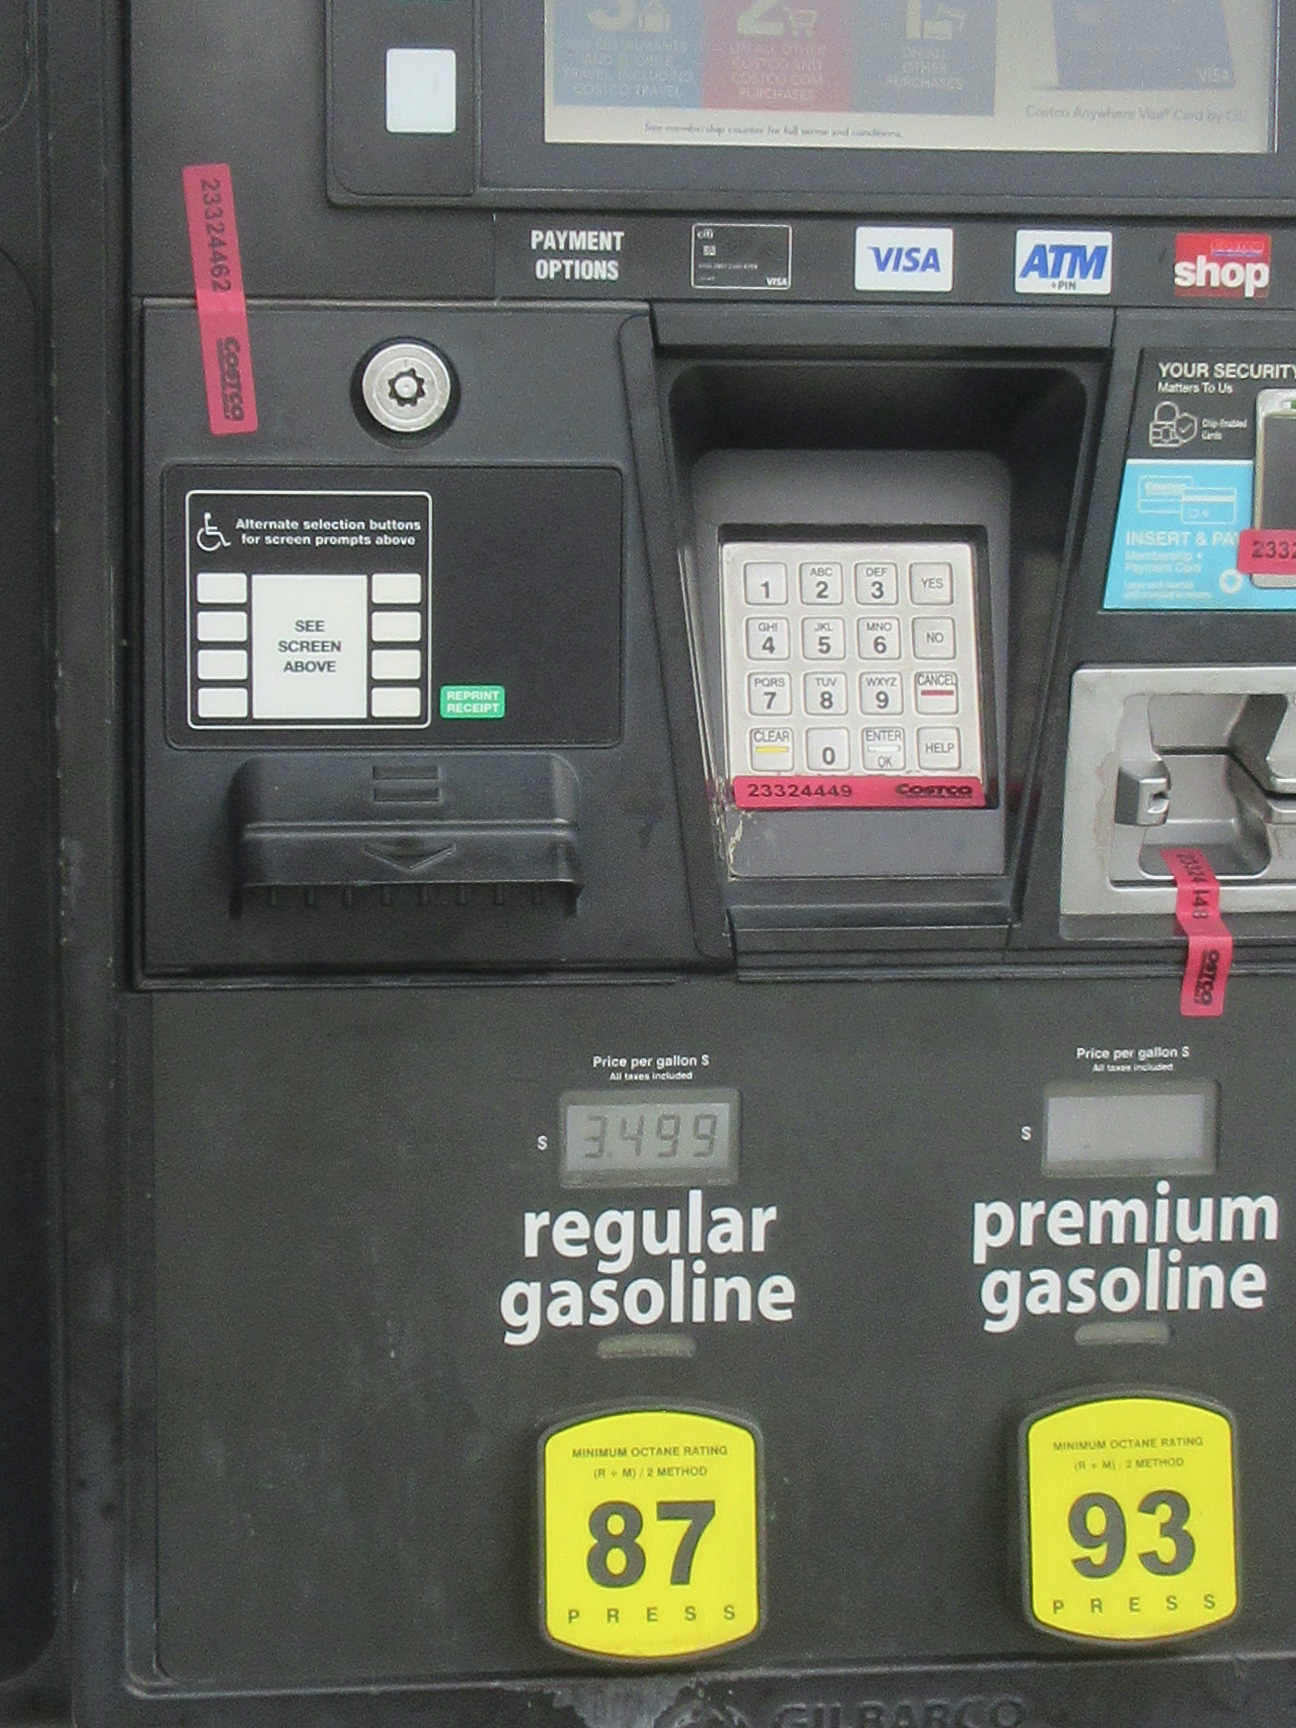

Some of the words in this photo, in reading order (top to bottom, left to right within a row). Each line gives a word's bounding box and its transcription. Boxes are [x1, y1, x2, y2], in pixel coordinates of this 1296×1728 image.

[531, 229, 625, 251] PAYMENT
[535, 258, 620, 281] OPTIONS
[871, 246, 941, 273] VISA
[1020, 244, 1109, 279] ATM
[1174, 255, 1270, 298] shop
[1158, 362, 1210, 379] YOUR
[235, 518, 300, 530] Alternate
[302, 518, 366, 531] selection
[368, 519, 422, 531] buttons
[240, 533, 261, 545] for
[264, 535, 312, 545] screen
[314, 534, 372, 547] prompts
[374, 534, 416, 546] above
[294, 619, 325, 633] SEE
[278, 639, 342, 653] SCREEN
[283, 660, 335, 673] ABOVE
[446, 690, 499, 701] REPRINT
[446, 702, 499, 714] RECEIPT
[747, 783, 854, 799] 23324449
[894, 783, 974, 798] COSTCO
[524, 1189, 777, 1276] regular
[973, 1180, 1279, 1265] premium
[500, 1254, 796, 1346] gasoline
[975, 1246, 1267, 1333] gasoline
[586, 1499, 716, 1589] 87
[1067, 1488, 1197, 1580] 93
